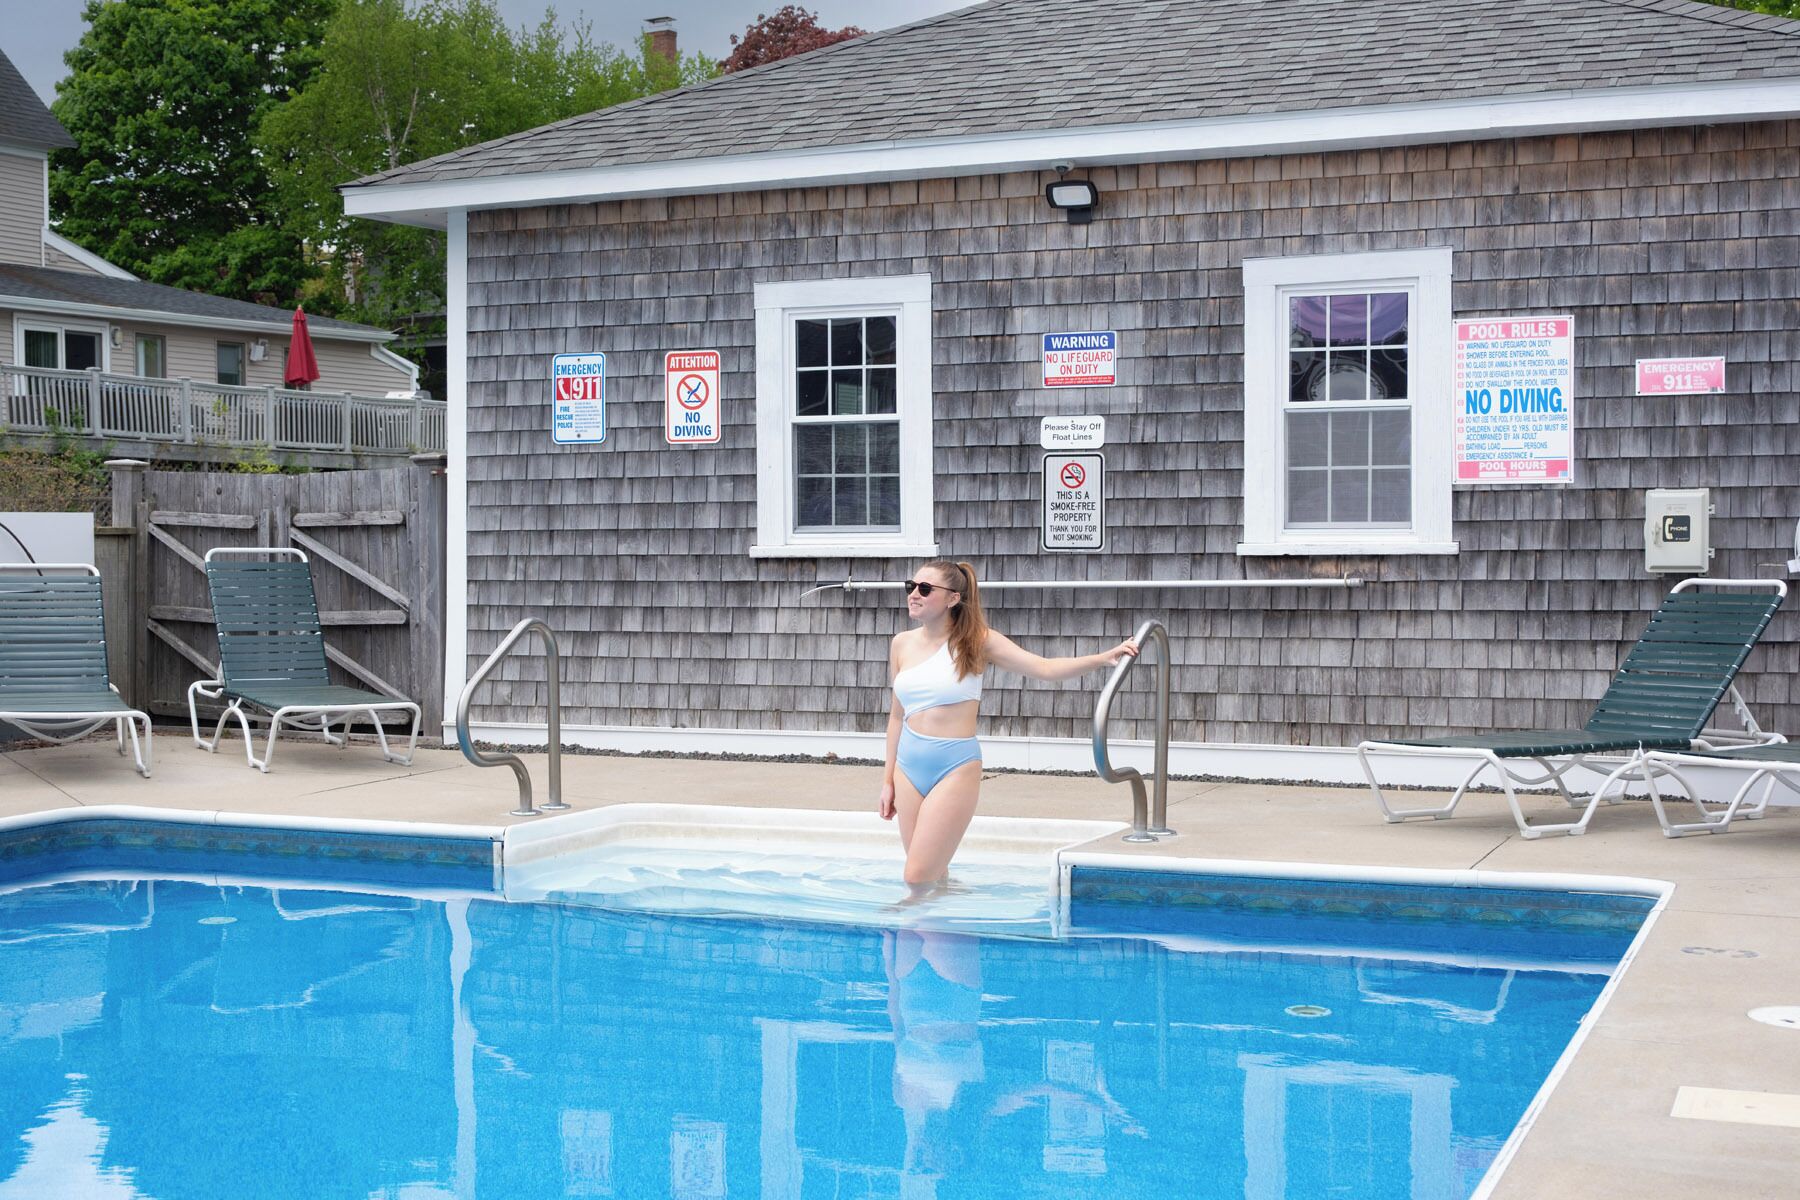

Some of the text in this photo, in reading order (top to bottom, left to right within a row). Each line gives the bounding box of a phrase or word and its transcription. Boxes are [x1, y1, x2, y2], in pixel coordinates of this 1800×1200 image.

[1469, 322, 1556, 339] POOL RULES
[1051, 335, 1108, 349] WARNING
[670, 355, 716, 368] ATTENTION
[1046, 351, 1112, 364] NO LIFEGUARD
[556, 363, 602, 375] EMERGENCY
[1059, 363, 1098, 375] ON DUTY
[1644, 362, 1716, 373] EMERGENCY
[572, 377, 601, 399] 911
[1663, 375, 1693, 390] 911
[1466, 387, 1567, 414] NO DIVING.
[685, 412, 700, 423] NO
[674, 425, 711, 436] DIVING
[1070, 424, 1088, 432] Stay
[1466, 425, 1491, 433] CHILDREN
[1479, 461, 1546, 470] POOL HOURS
[1057, 491, 1073, 499] THIS
[1050, 502, 1096, 511] SMOKE-FREE
[1054, 513, 1091, 522] PROPERTY
